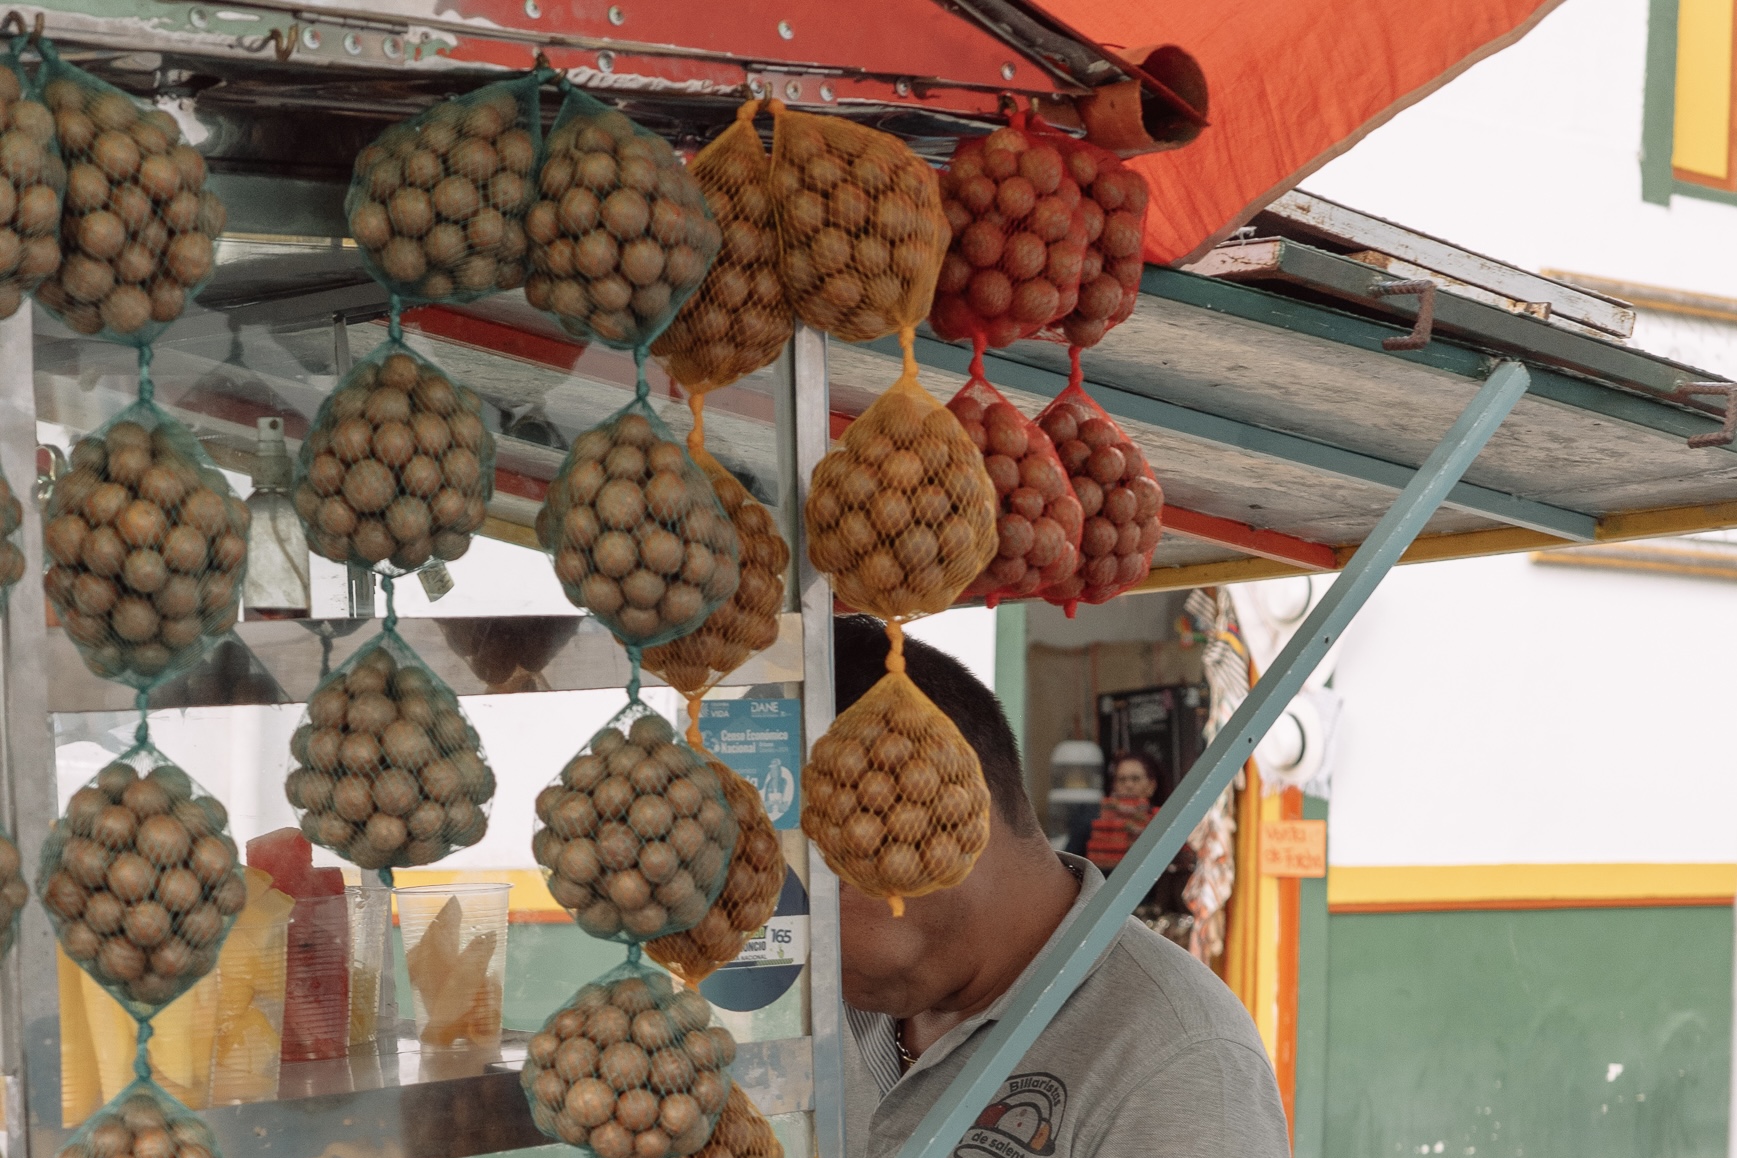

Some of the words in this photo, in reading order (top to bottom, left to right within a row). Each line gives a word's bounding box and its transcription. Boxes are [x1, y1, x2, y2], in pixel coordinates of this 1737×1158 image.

[750, 702, 779, 713] DANE
[721, 742, 756, 753] Nacional
[771, 929, 792, 943] 165
[744, 941, 767, 952] UNCIO
[971, 1131, 988, 1145] de
